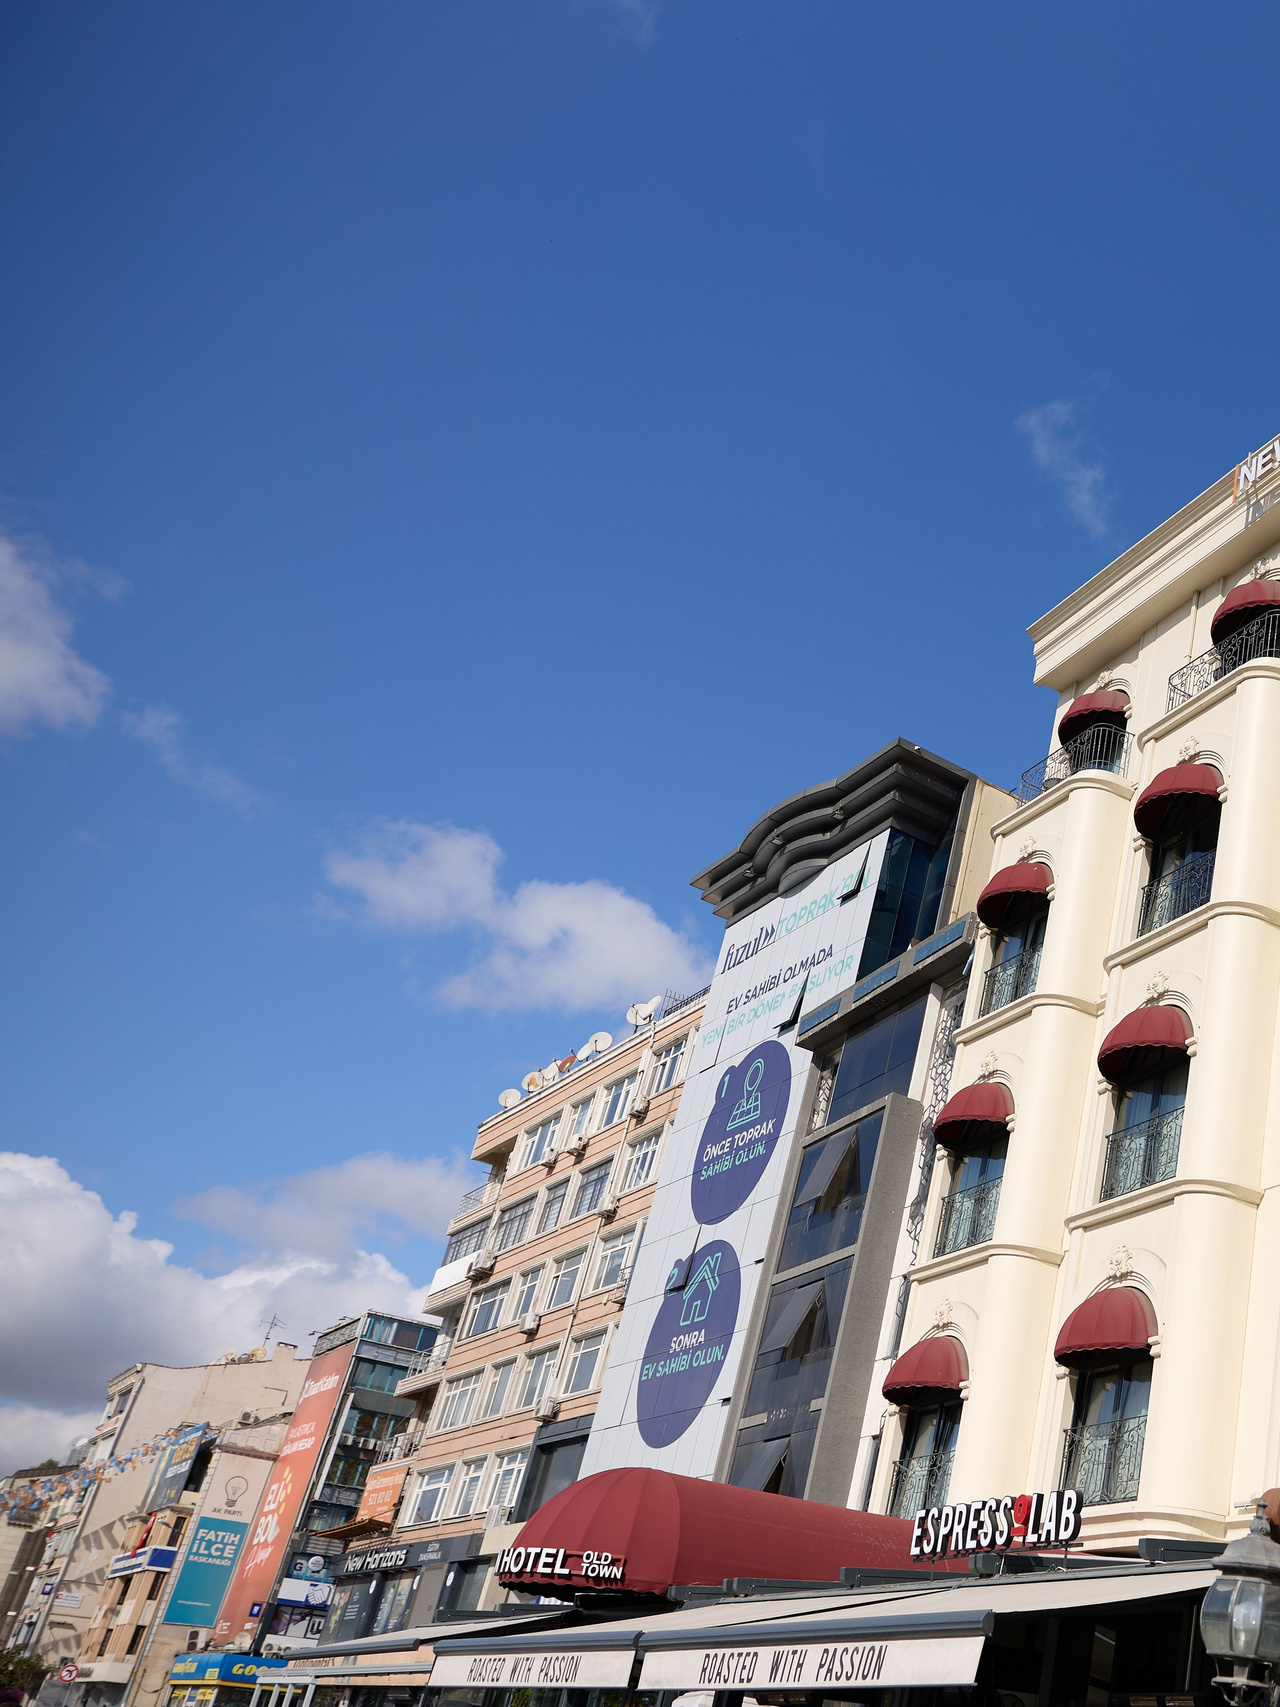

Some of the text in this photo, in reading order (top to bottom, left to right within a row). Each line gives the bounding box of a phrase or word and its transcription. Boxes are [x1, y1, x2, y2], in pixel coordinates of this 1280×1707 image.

[726, 944, 833, 1015] EV SAHİBİ OLMADA
[727, 1013, 746, 1035] BİR
[721, 1074, 730, 1098] 1
[703, 1118, 776, 1162] ÖNCE TOPRAK
[700, 1140, 766, 1181] SAHİBİ OLUN.
[665, 1267, 679, 1297] 2
[669, 1328, 705, 1354] SONRA
[641, 1344, 725, 1381] EV SAHİBİ OLUN.
[344, 1554, 367, 1573] New
[363, 1548, 408, 1570] Horizons
[499, 1547, 612, 1575] HOTEL OLD
[581, 1563, 623, 1580] TOWN
[466, 1655, 582, 1683] ROASTED WITH PASSION
[698, 1644, 888, 1684] ROASTED WITH PASSION
